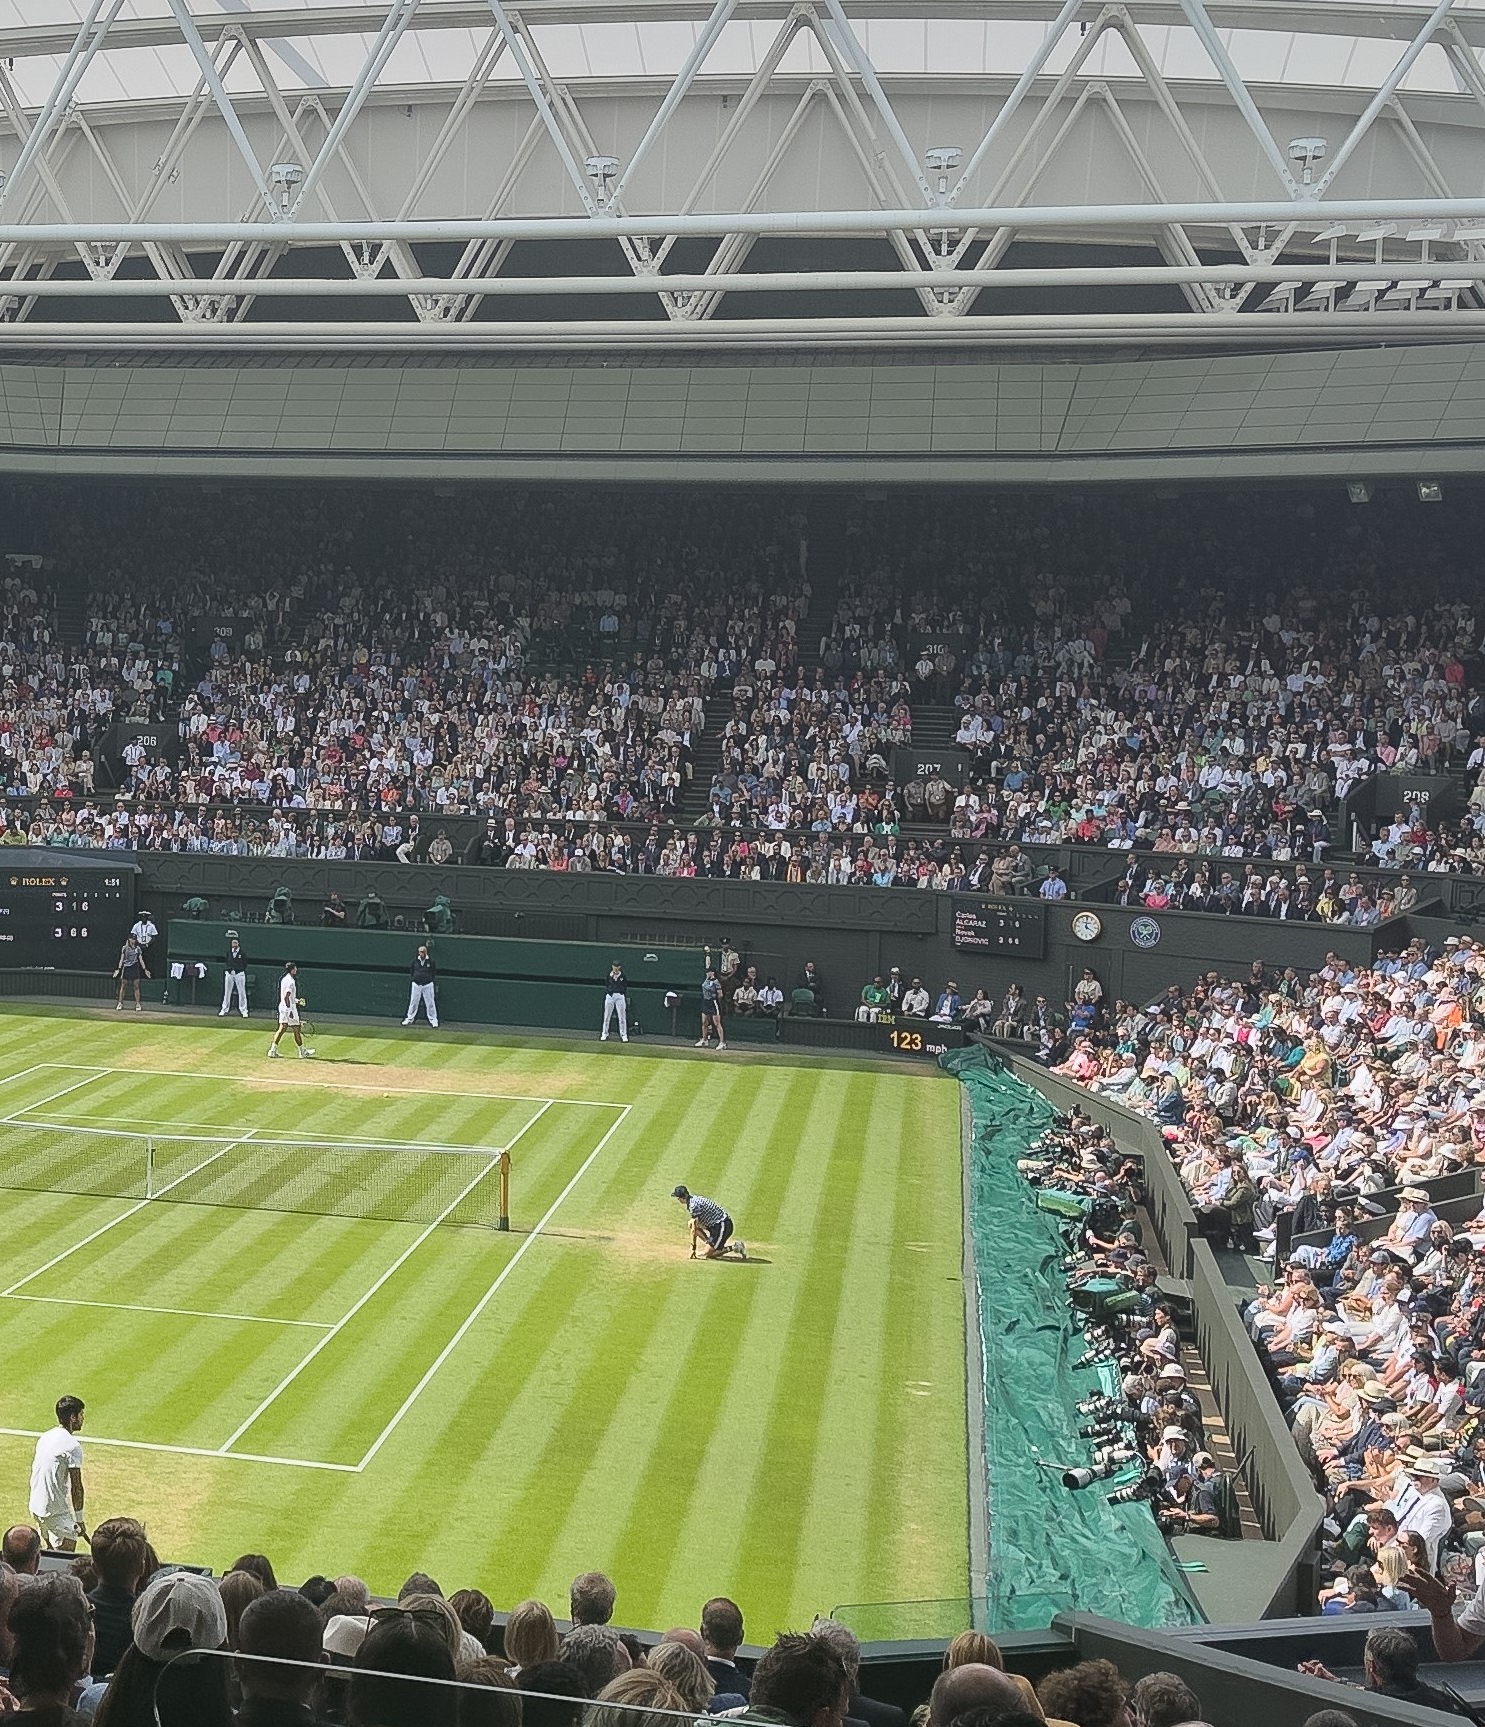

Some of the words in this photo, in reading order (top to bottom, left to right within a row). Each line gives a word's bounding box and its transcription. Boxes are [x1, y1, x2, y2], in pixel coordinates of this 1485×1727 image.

[136, 735, 157, 747] 206
[22, 877, 56, 886] ROLEX
[55, 901, 63, 911] 3
[72, 901, 77, 911] 1
[81, 901, 89, 911] 6
[54, 927, 62, 938] 3
[70, 927, 77, 937] 6
[81, 927, 88, 938] 6
[877, 1013, 896, 1025] IBM
[889, 1030, 922, 1050] 123
[926, 1043, 948, 1055] mph
